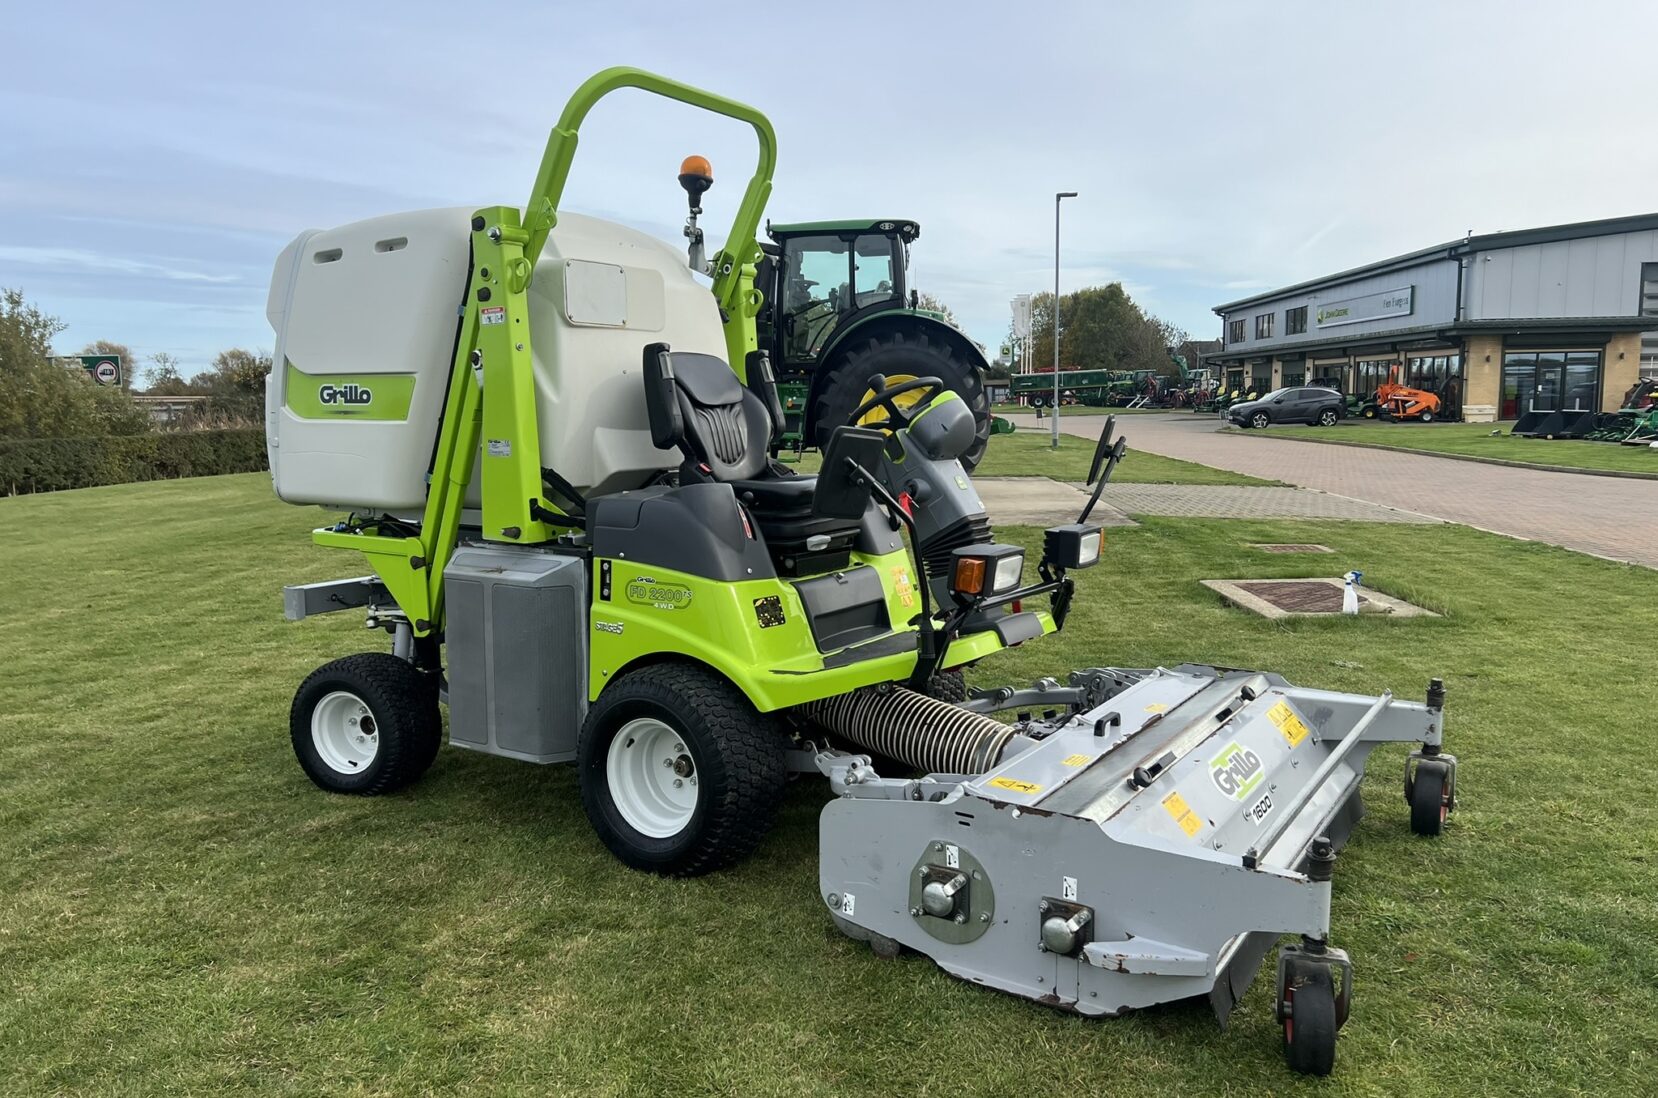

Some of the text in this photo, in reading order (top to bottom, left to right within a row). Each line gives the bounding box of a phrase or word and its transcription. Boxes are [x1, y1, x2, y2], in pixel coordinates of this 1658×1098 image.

[319, 384, 372, 405] Grillo
[630, 585, 646, 598] FD
[654, 602, 674, 610] 4WD
[1213, 750, 1261, 796] Grillo
[1252, 795, 1272, 820] 1600
